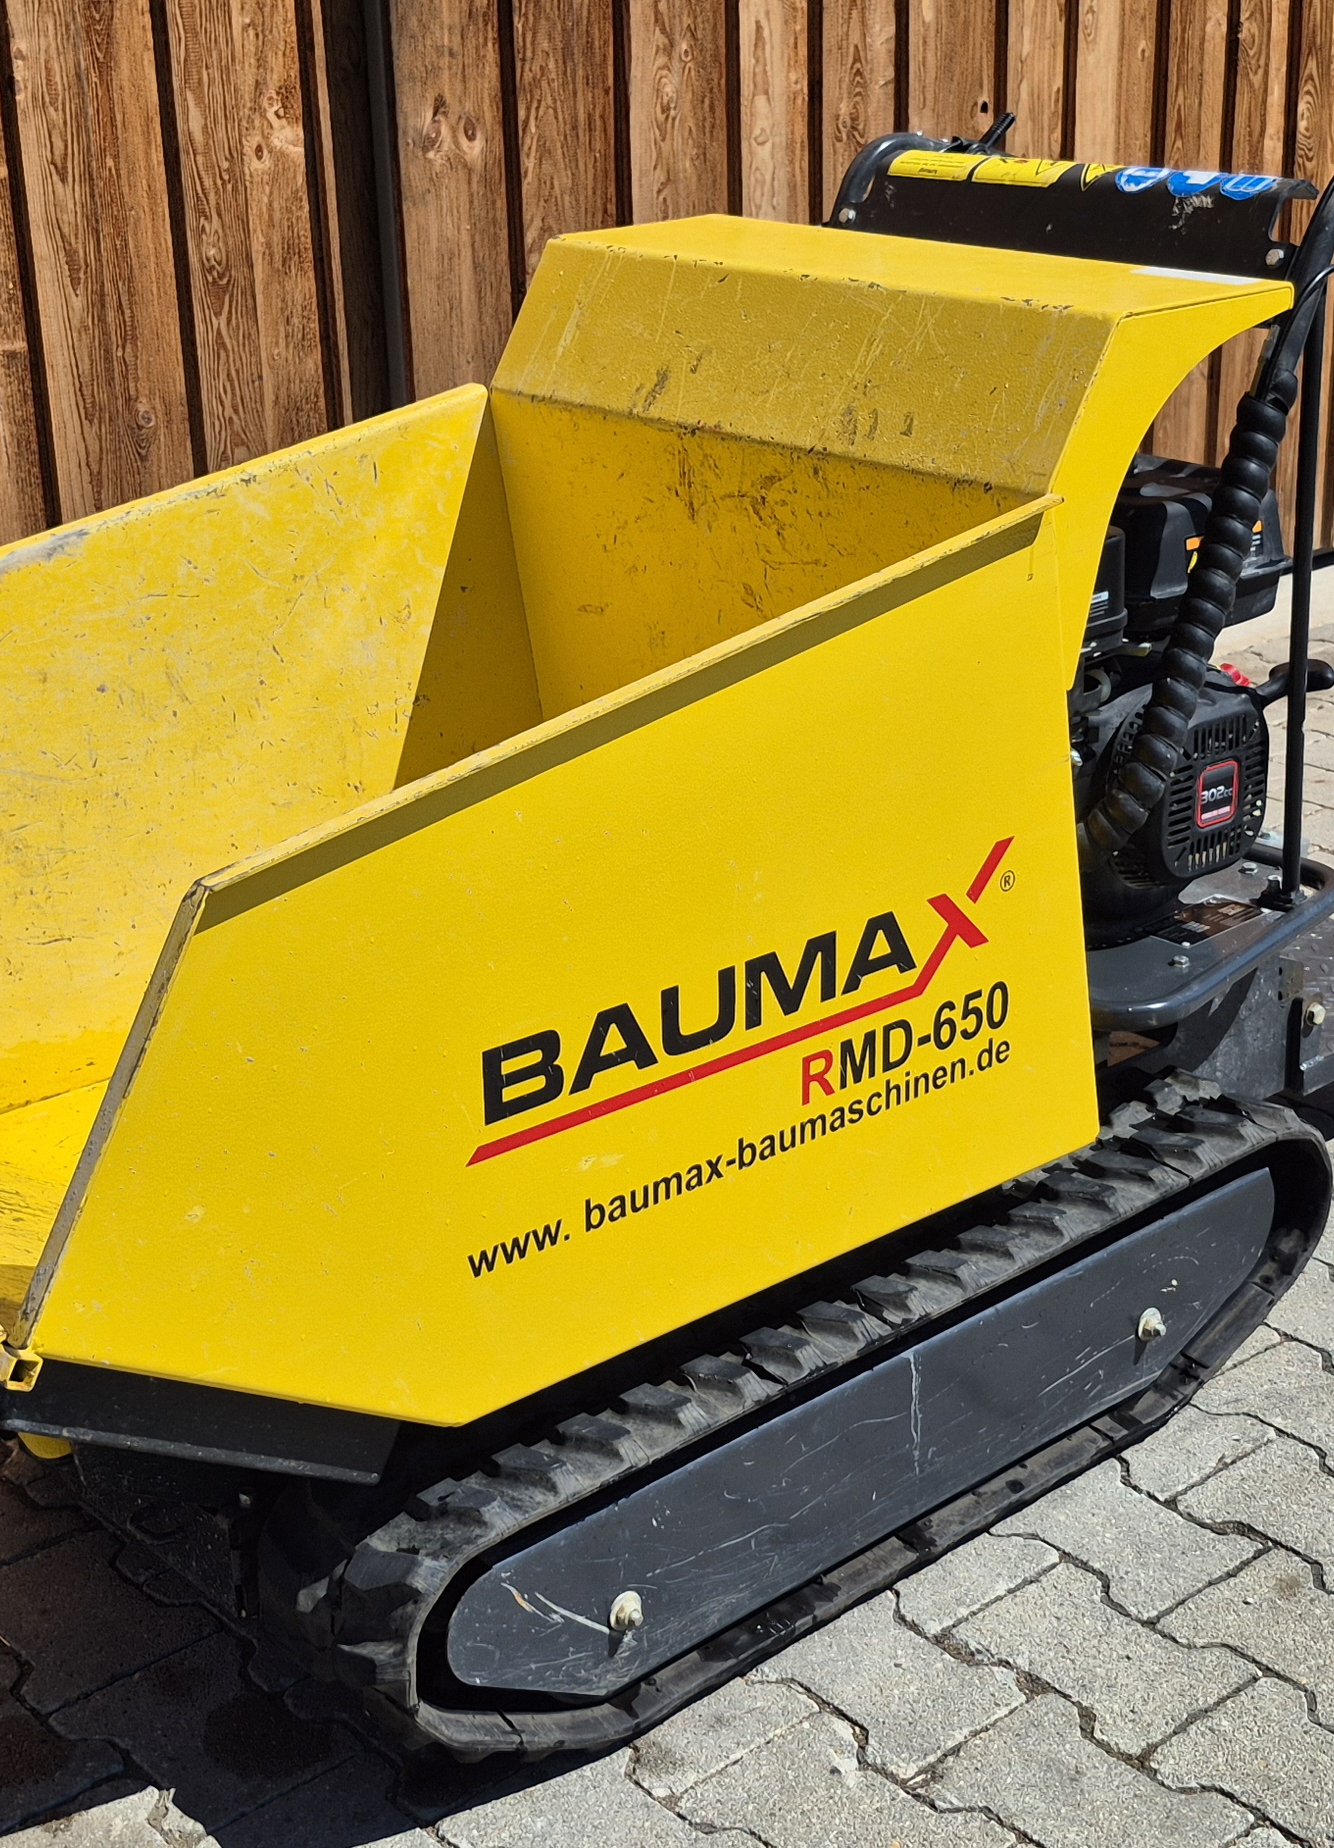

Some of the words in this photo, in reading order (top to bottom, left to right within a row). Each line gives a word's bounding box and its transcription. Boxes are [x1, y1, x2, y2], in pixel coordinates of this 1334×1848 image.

[1200, 785, 1233, 805] 302cc
[801, 980, 1010, 1106] RMD-650
[466, 1217, 570, 1279] www.
[584, 1037, 1010, 1232] baumax-baumaschinen.de
